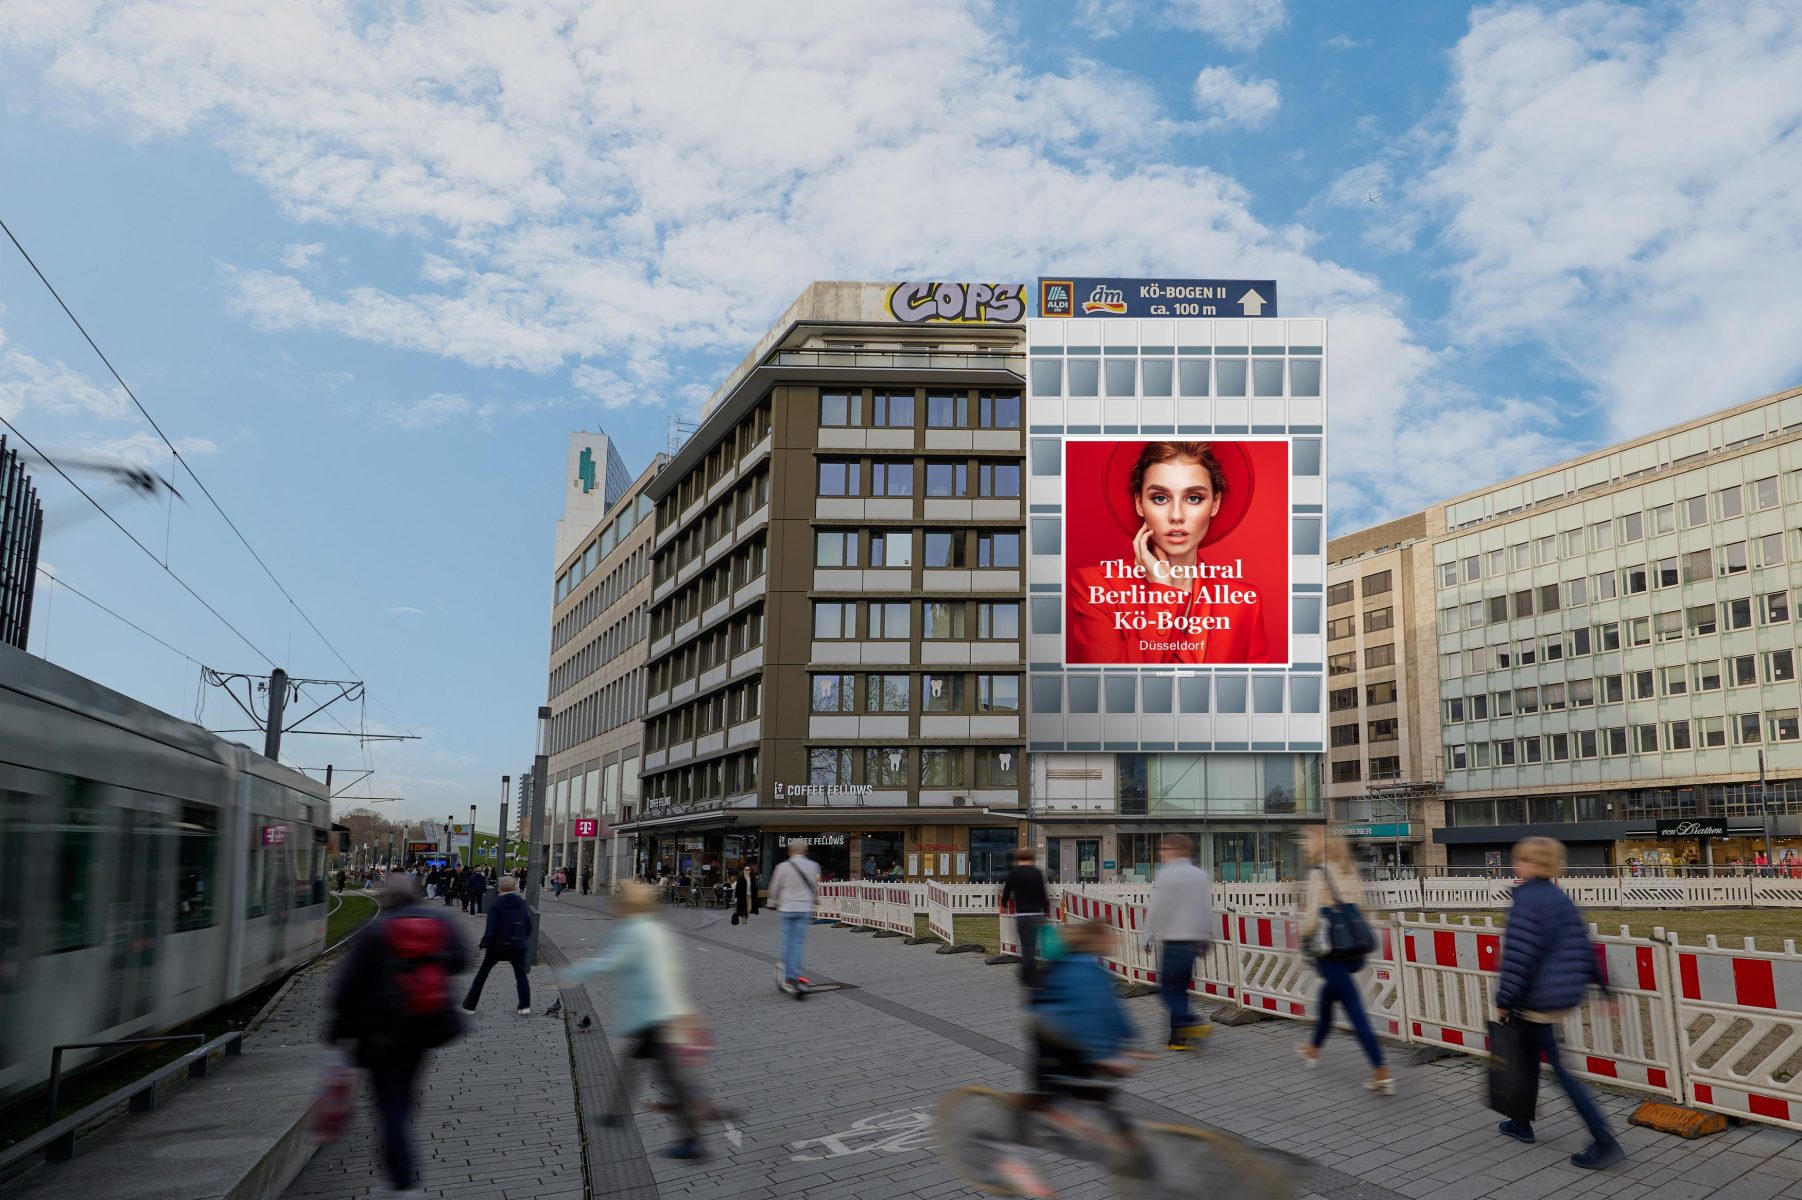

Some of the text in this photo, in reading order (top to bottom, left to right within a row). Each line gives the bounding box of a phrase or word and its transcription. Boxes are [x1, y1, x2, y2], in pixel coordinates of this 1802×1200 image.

[1091, 285, 1122, 303] dm
[1140, 283, 1226, 298] KÖ-BOGEN II
[890, 281, 1025, 323] COPS
[1150, 303, 1216, 315] ca. 100 m
[1101, 559, 1243, 579] The Central
[1088, 585, 1257, 605] Berliner Allee
[1113, 611, 1231, 634] Kö-Bogen
[1140, 640, 1206, 651] Düsseldorf
[787, 784, 873, 796] COFFEE FELLOWS
[580, 821, 592, 835] T
[814, 836, 844, 846] FELLOWS
